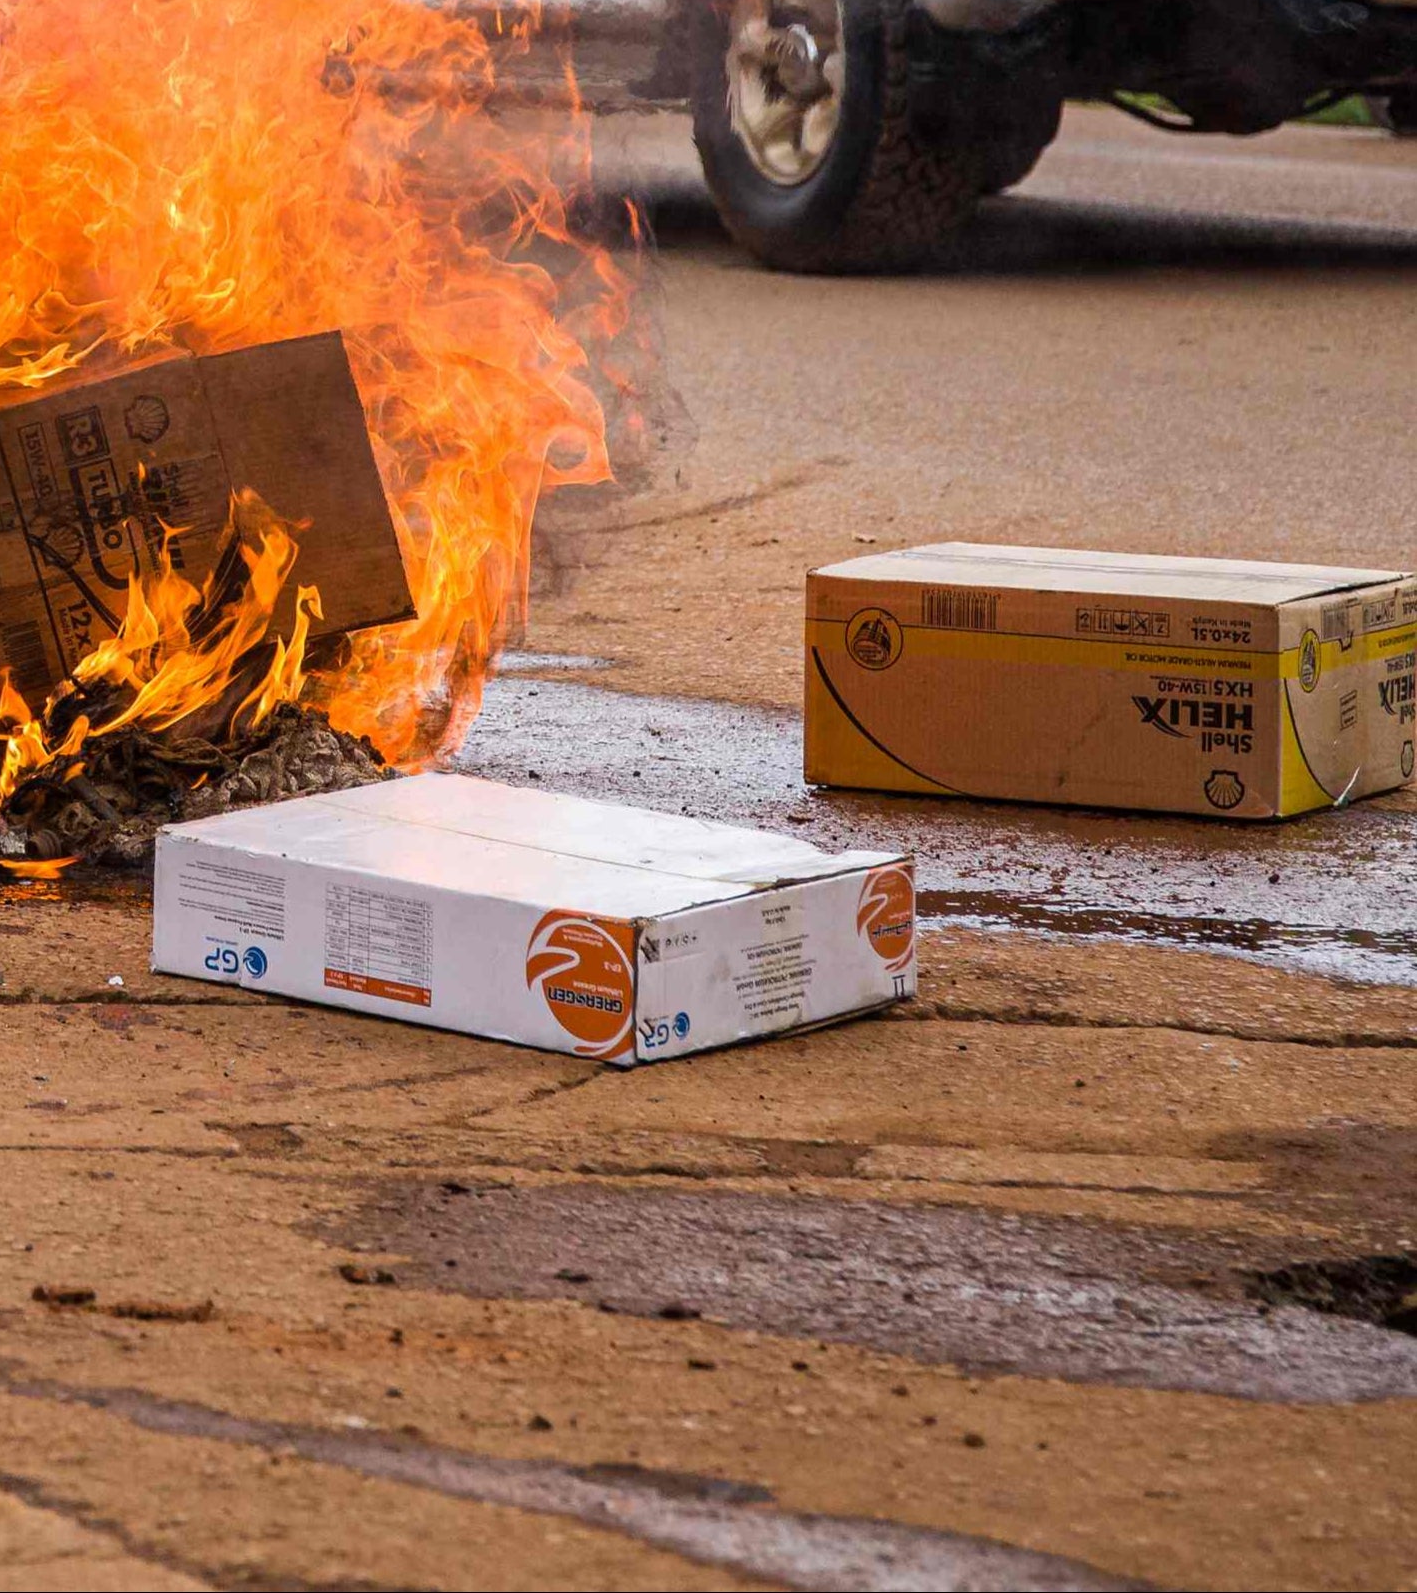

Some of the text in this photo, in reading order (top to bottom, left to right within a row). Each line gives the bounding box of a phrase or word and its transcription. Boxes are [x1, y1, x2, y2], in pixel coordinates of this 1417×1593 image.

[1190, 627, 1251, 644] 24x0.5L
[1124, 652, 1137, 662] OIL
[1137, 653, 1166, 664] MOTOR
[1217, 659, 1252, 670] PREMIUM
[1157, 679, 1254, 697] HX5 15W-40
[1131, 695, 1254, 739] HELIX
[1201, 731, 1254, 754] Shell
[204, 947, 239, 975] GP
